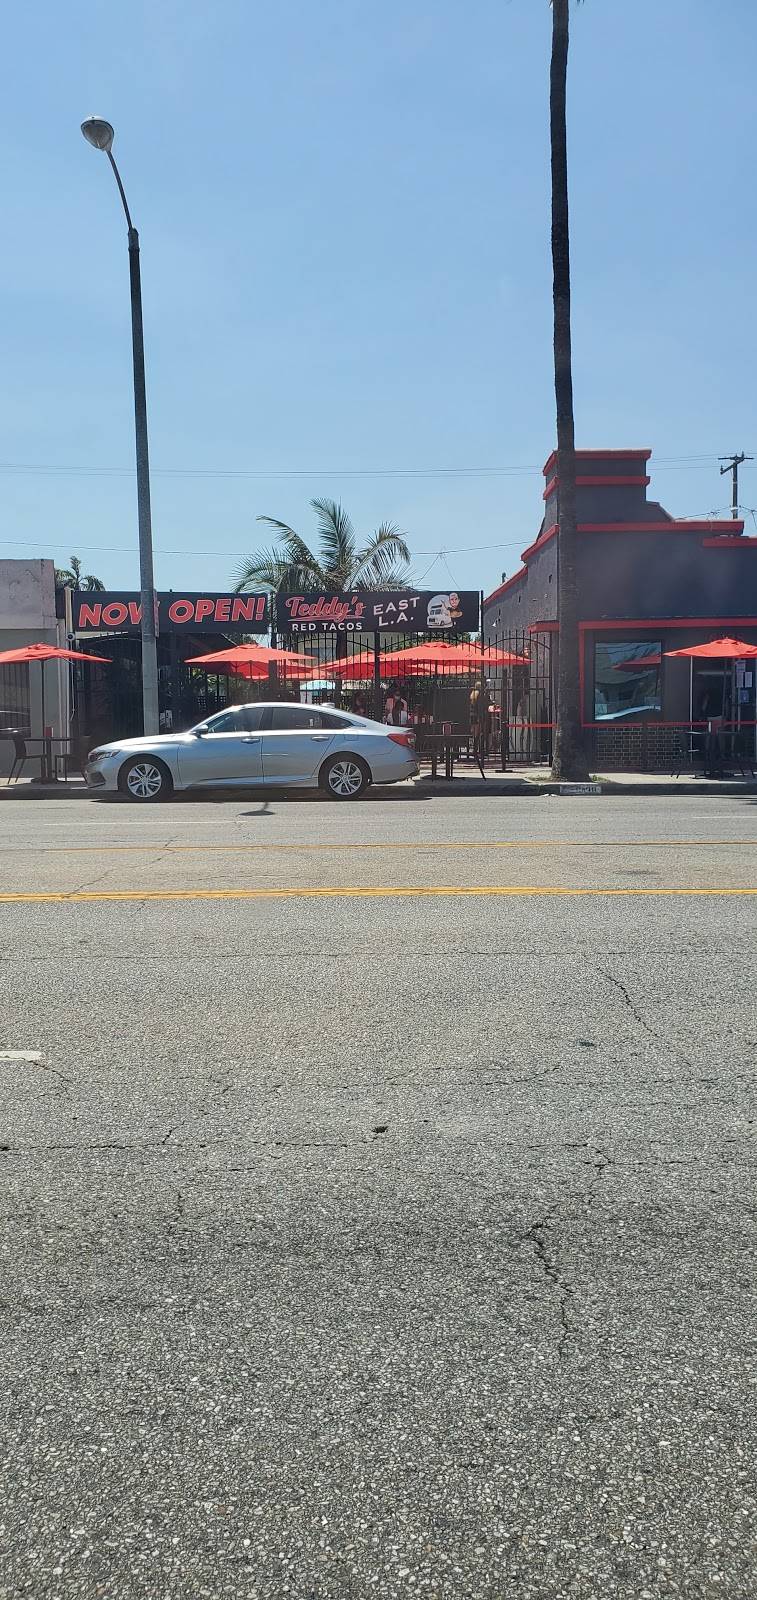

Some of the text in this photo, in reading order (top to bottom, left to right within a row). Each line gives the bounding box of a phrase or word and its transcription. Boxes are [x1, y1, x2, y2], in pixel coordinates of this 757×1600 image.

[168, 597, 265, 623] OPEN!
[285, 596, 366, 622] Teddy's
[373, 596, 421, 615] EAST
[292, 622, 363, 631] RED TACOS
[378, 612, 414, 627] L.A.
